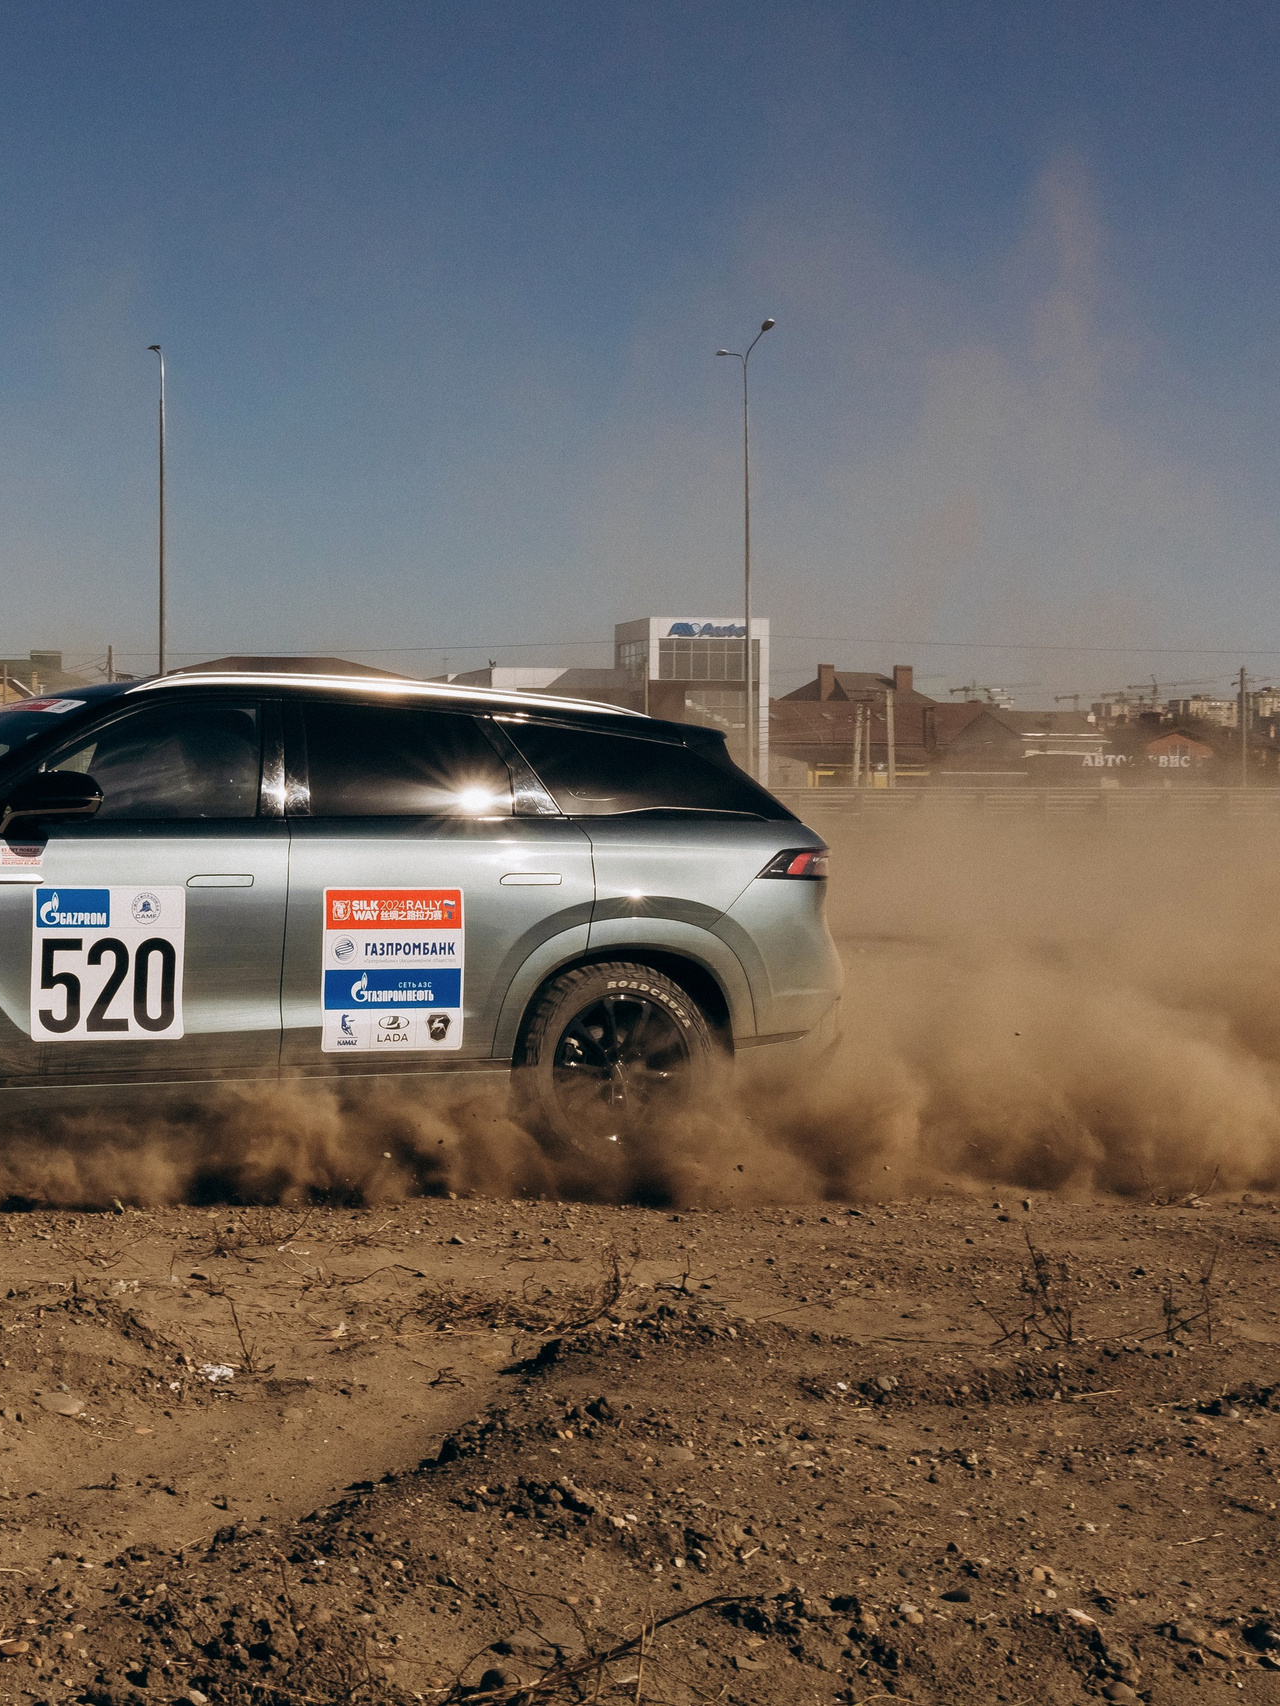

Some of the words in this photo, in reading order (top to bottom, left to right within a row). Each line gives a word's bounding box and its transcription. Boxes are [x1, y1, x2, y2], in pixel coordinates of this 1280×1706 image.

[352, 900, 379, 910] SILK
[380, 900, 405, 910] 2024
[406, 900, 442, 910] RALLY
[59, 912, 107, 926] GAZPROM
[352, 910, 379, 921] WAY
[364, 942, 456, 956] ГАЗПРОМБАНК
[38, 937, 176, 1034] 520
[367, 989, 434, 1002] ГАЗПРОМНЕФТЬ
[607, 980, 691, 1028] ROADCRUZA
[376, 1033, 409, 1043] LADA
